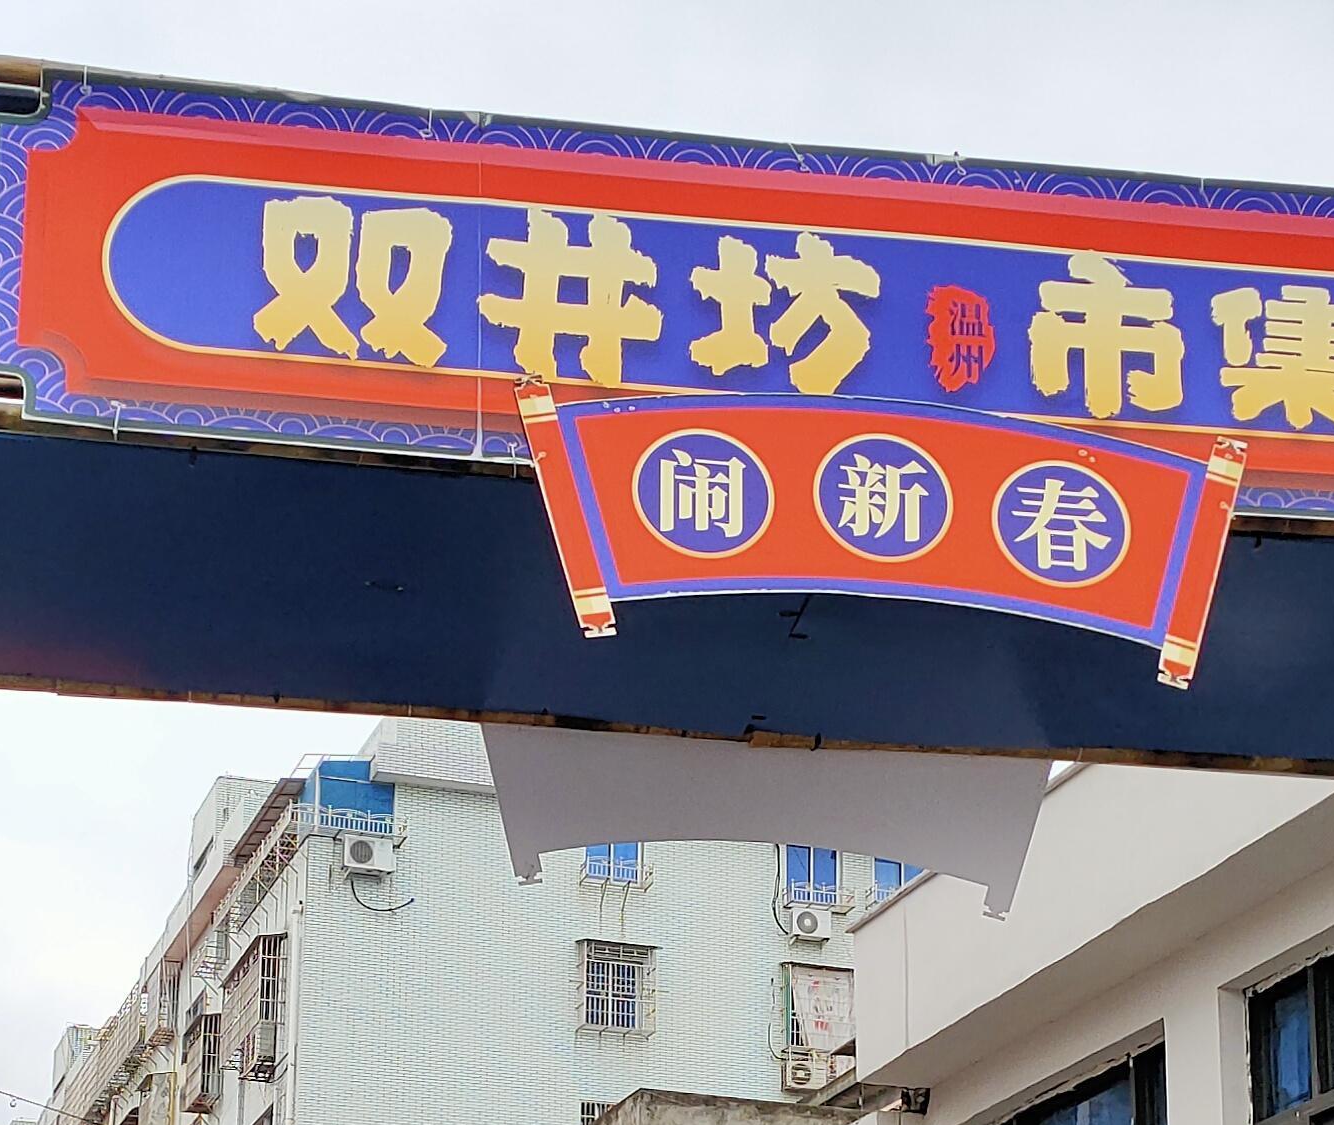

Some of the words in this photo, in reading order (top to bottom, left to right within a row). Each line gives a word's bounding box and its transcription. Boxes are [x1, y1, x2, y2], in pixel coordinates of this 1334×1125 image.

[254, 192, 881, 396] 双井坊
[948, 301, 986, 379] 温州
[659, 453, 1112, 572] 闹新春
